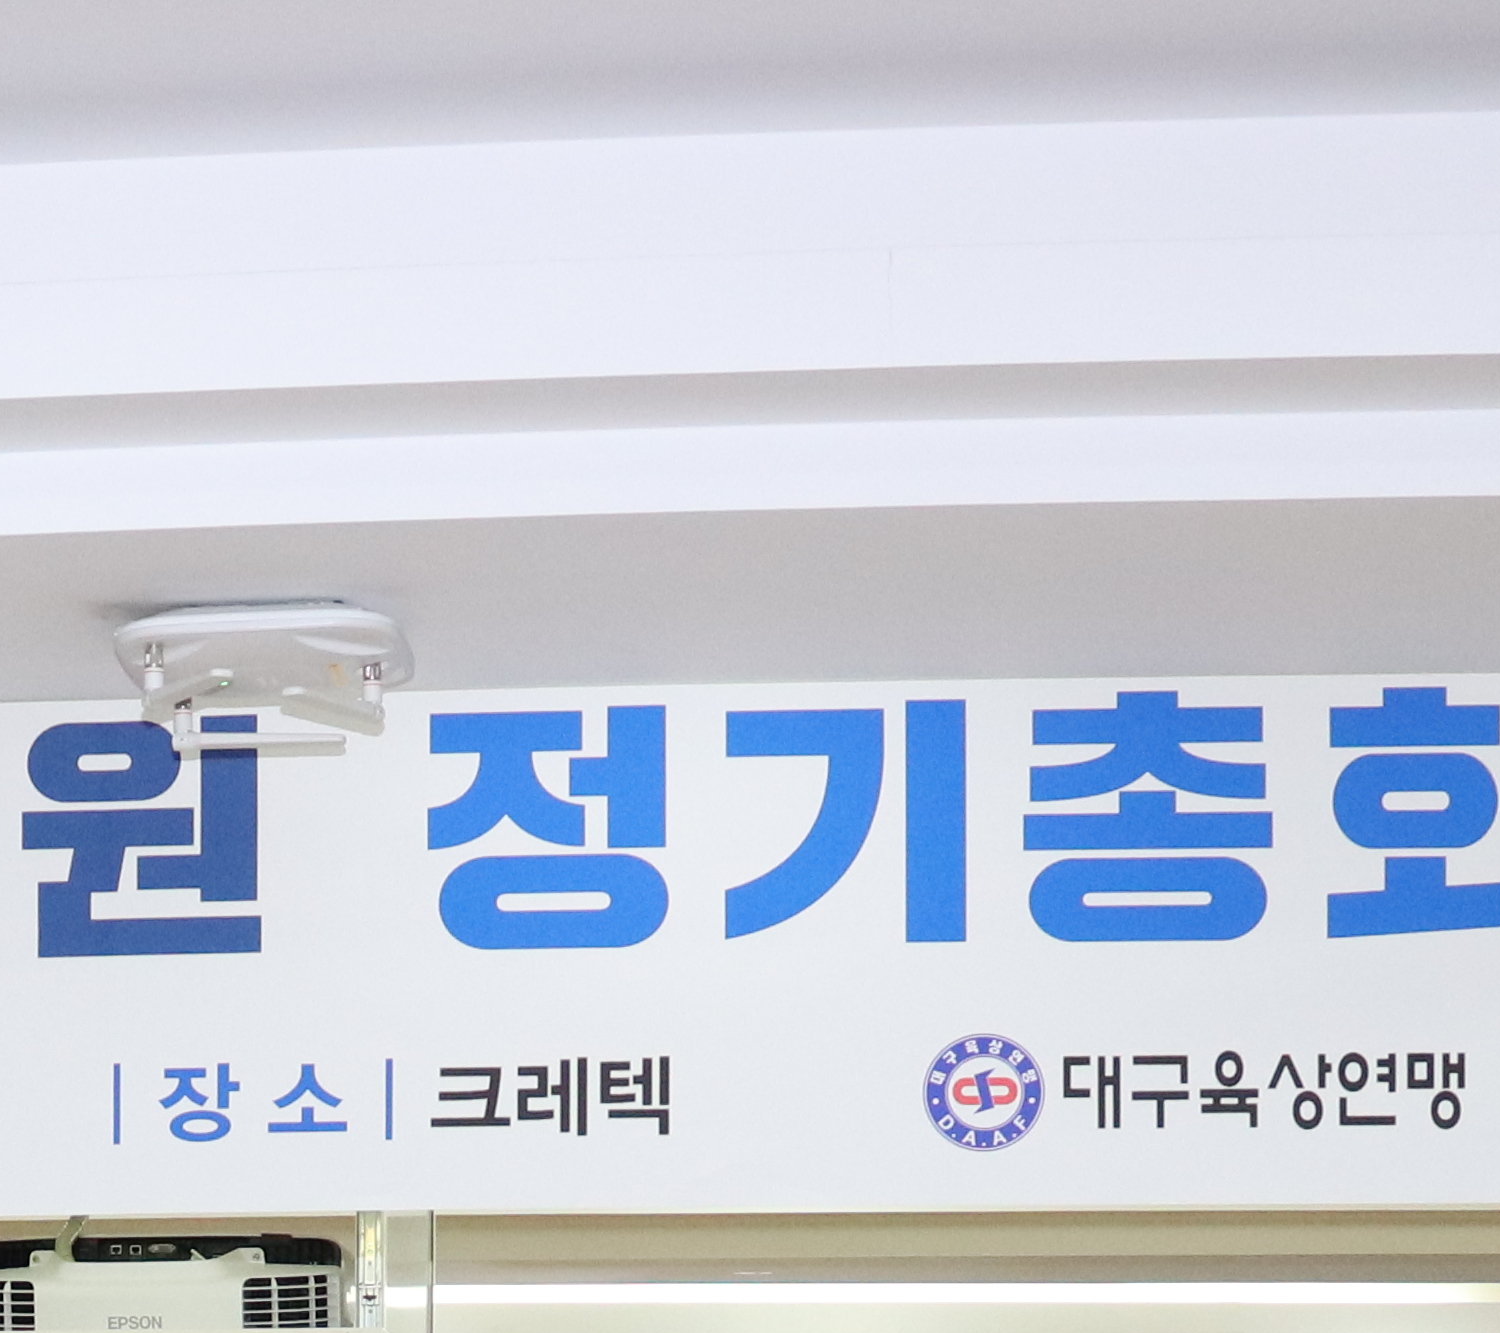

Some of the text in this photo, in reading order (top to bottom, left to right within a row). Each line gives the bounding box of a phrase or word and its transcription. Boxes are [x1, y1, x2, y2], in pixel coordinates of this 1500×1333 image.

[431, 1056, 669, 1136] 크레텍
[1063, 1051, 1465, 1130] 대구육상연맹
[107, 1315, 163, 1330] EPSON
